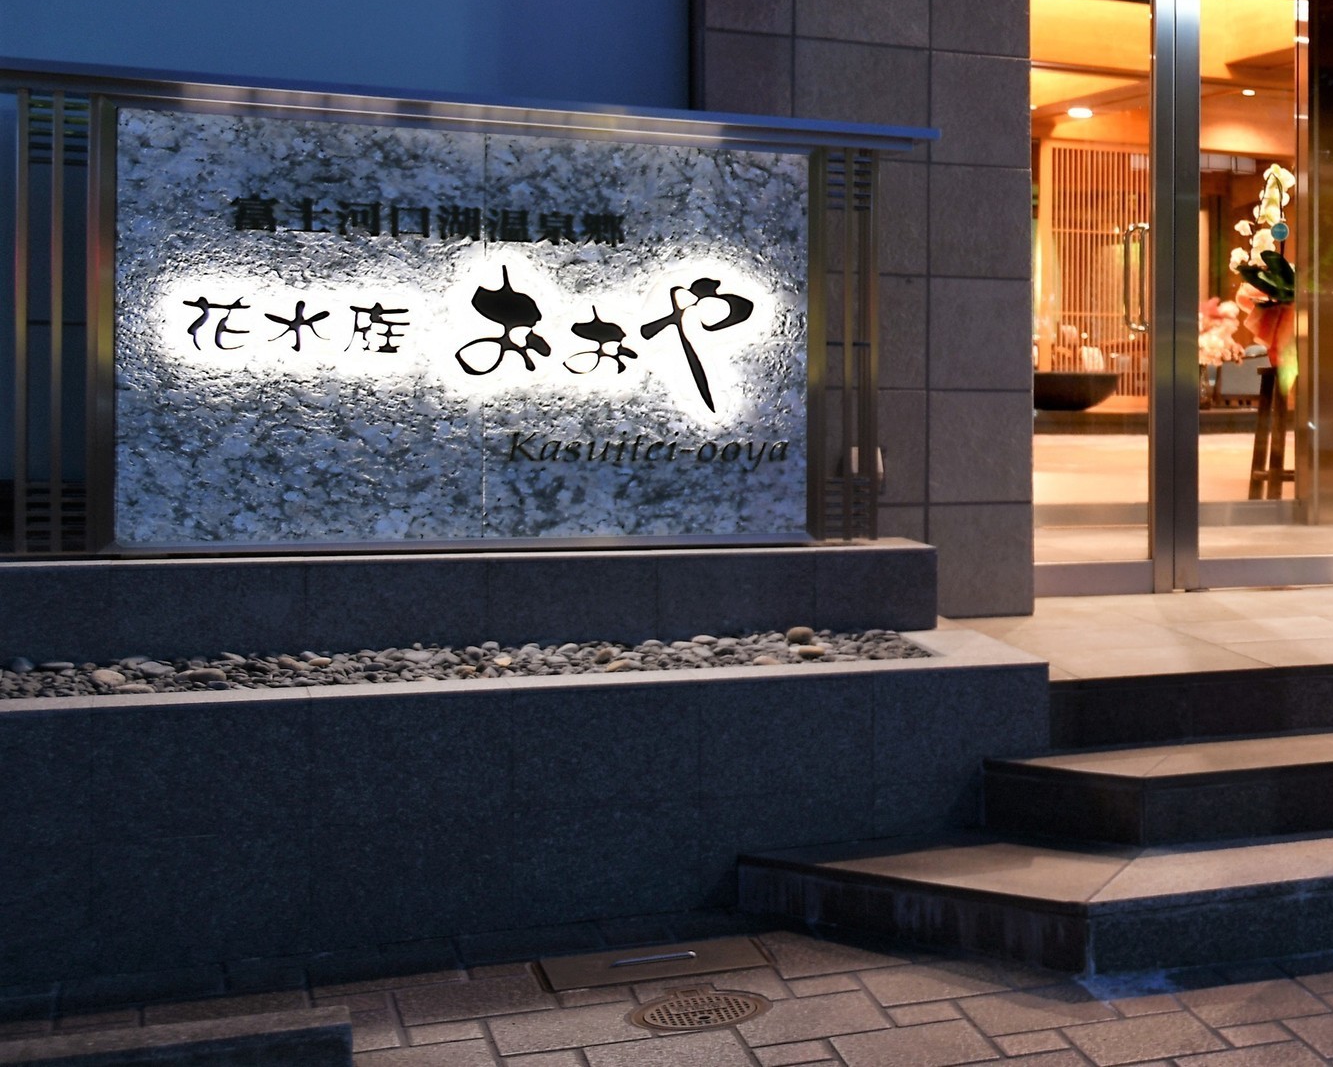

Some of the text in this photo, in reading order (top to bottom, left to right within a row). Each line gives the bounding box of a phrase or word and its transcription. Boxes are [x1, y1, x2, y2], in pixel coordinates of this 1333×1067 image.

[231, 196, 626, 247] 富士河口湖温泉郷
[455, 265, 755, 413] おおや
[509, 430, 791, 472] Kasuitei-ooya
